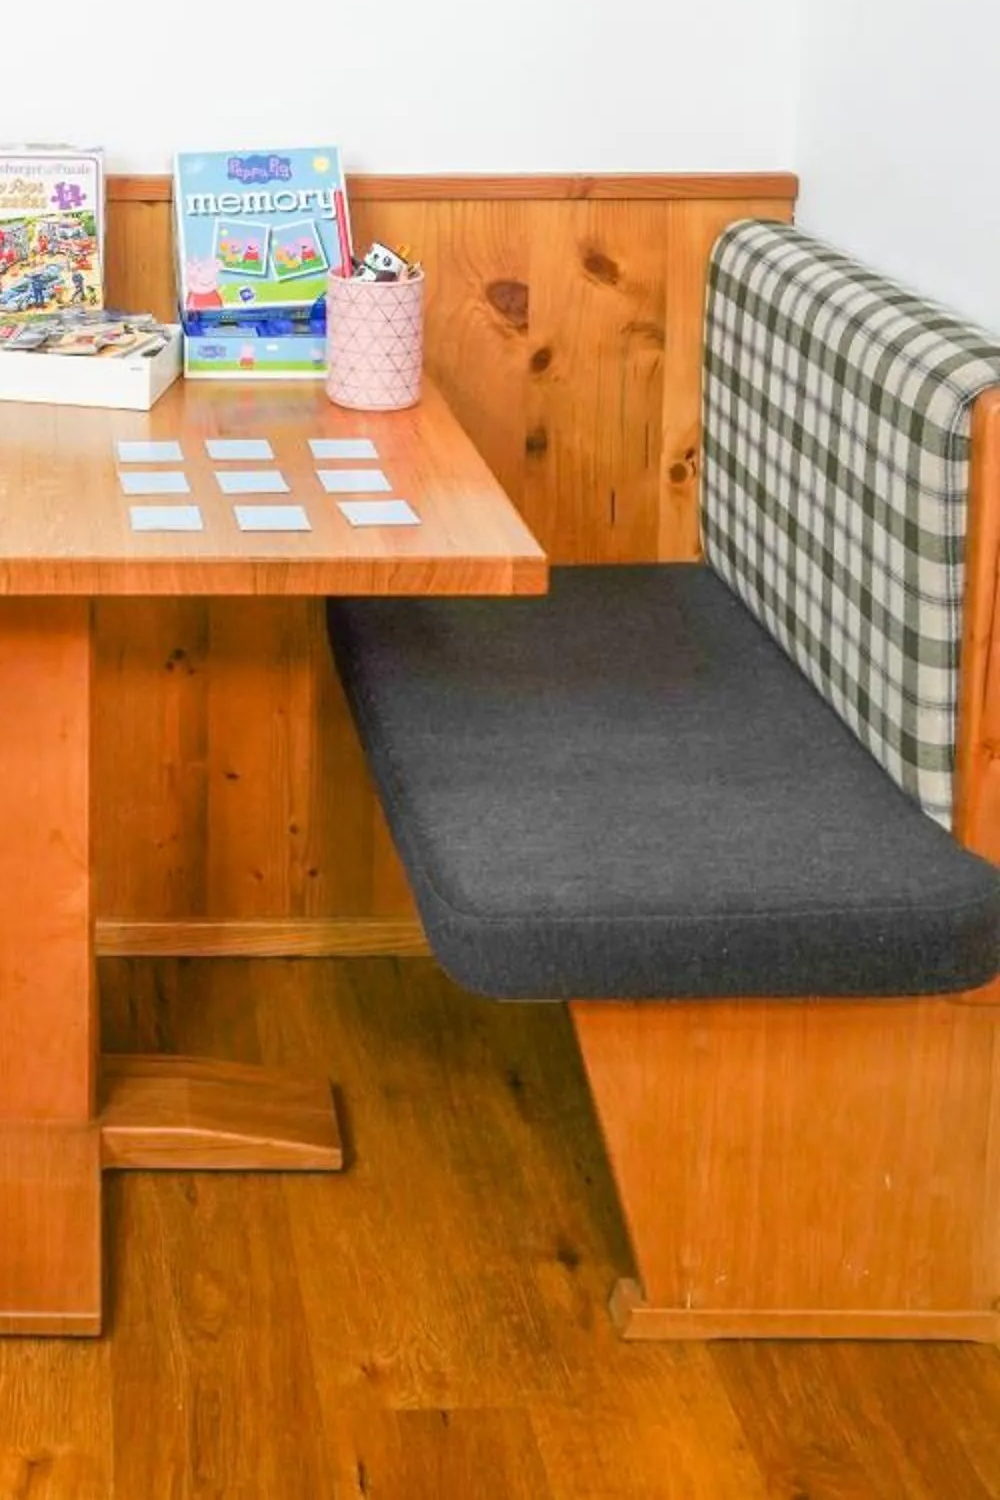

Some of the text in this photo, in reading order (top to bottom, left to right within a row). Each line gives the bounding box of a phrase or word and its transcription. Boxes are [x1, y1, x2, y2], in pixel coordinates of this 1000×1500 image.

[229, 157, 291, 180] Peppa Pig
[186, 185, 337, 220] memory
